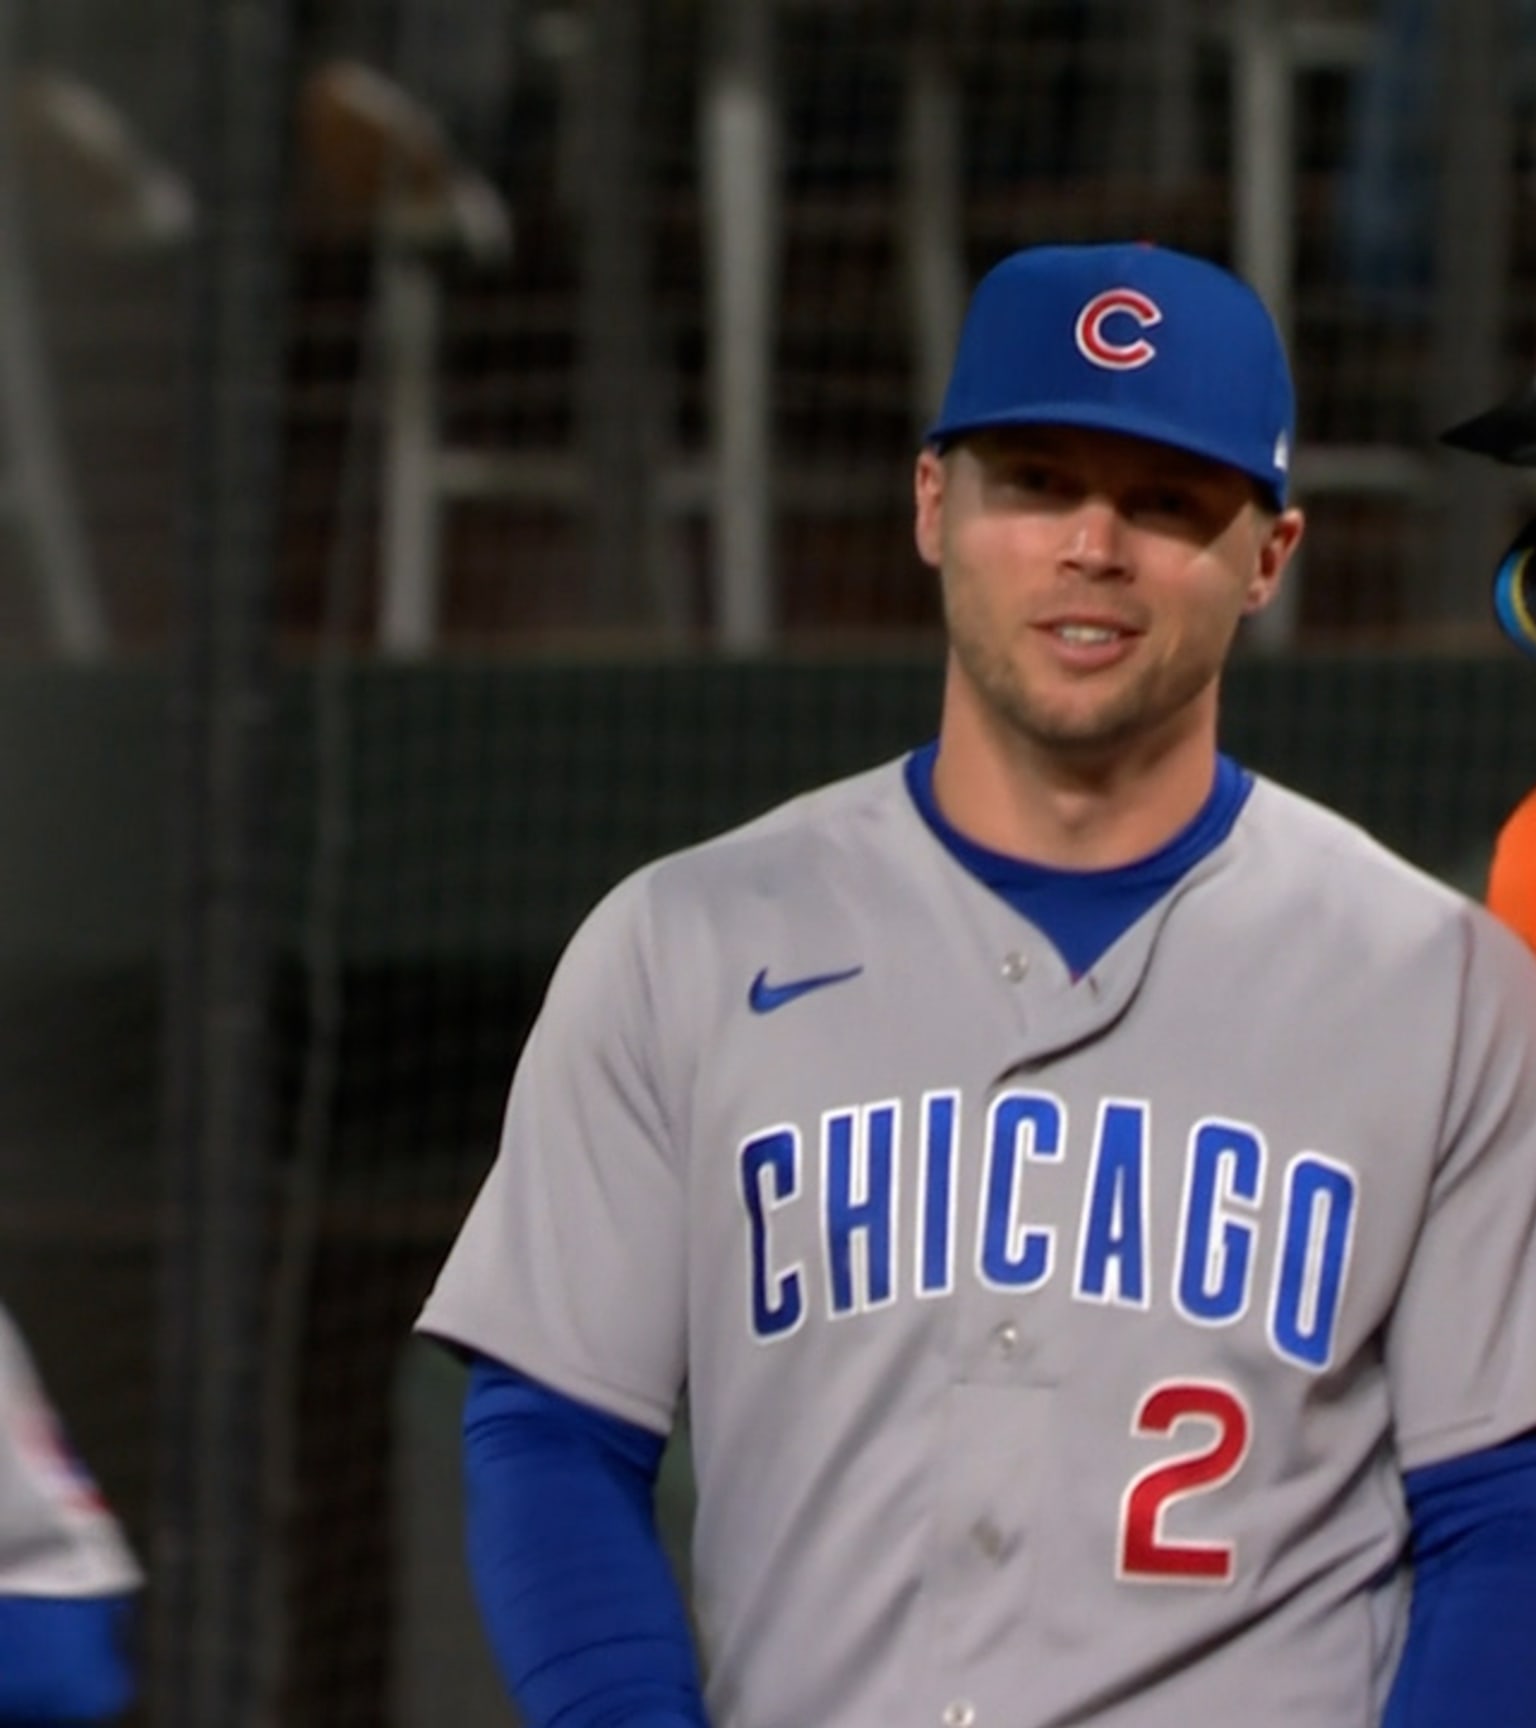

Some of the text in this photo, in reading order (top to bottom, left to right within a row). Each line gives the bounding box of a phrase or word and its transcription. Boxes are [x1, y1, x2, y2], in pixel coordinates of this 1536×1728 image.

[1075, 287, 1162, 370] C
[738, 1089, 1356, 1372] CHICAGO
[1116, 1377, 1249, 1584] 2
